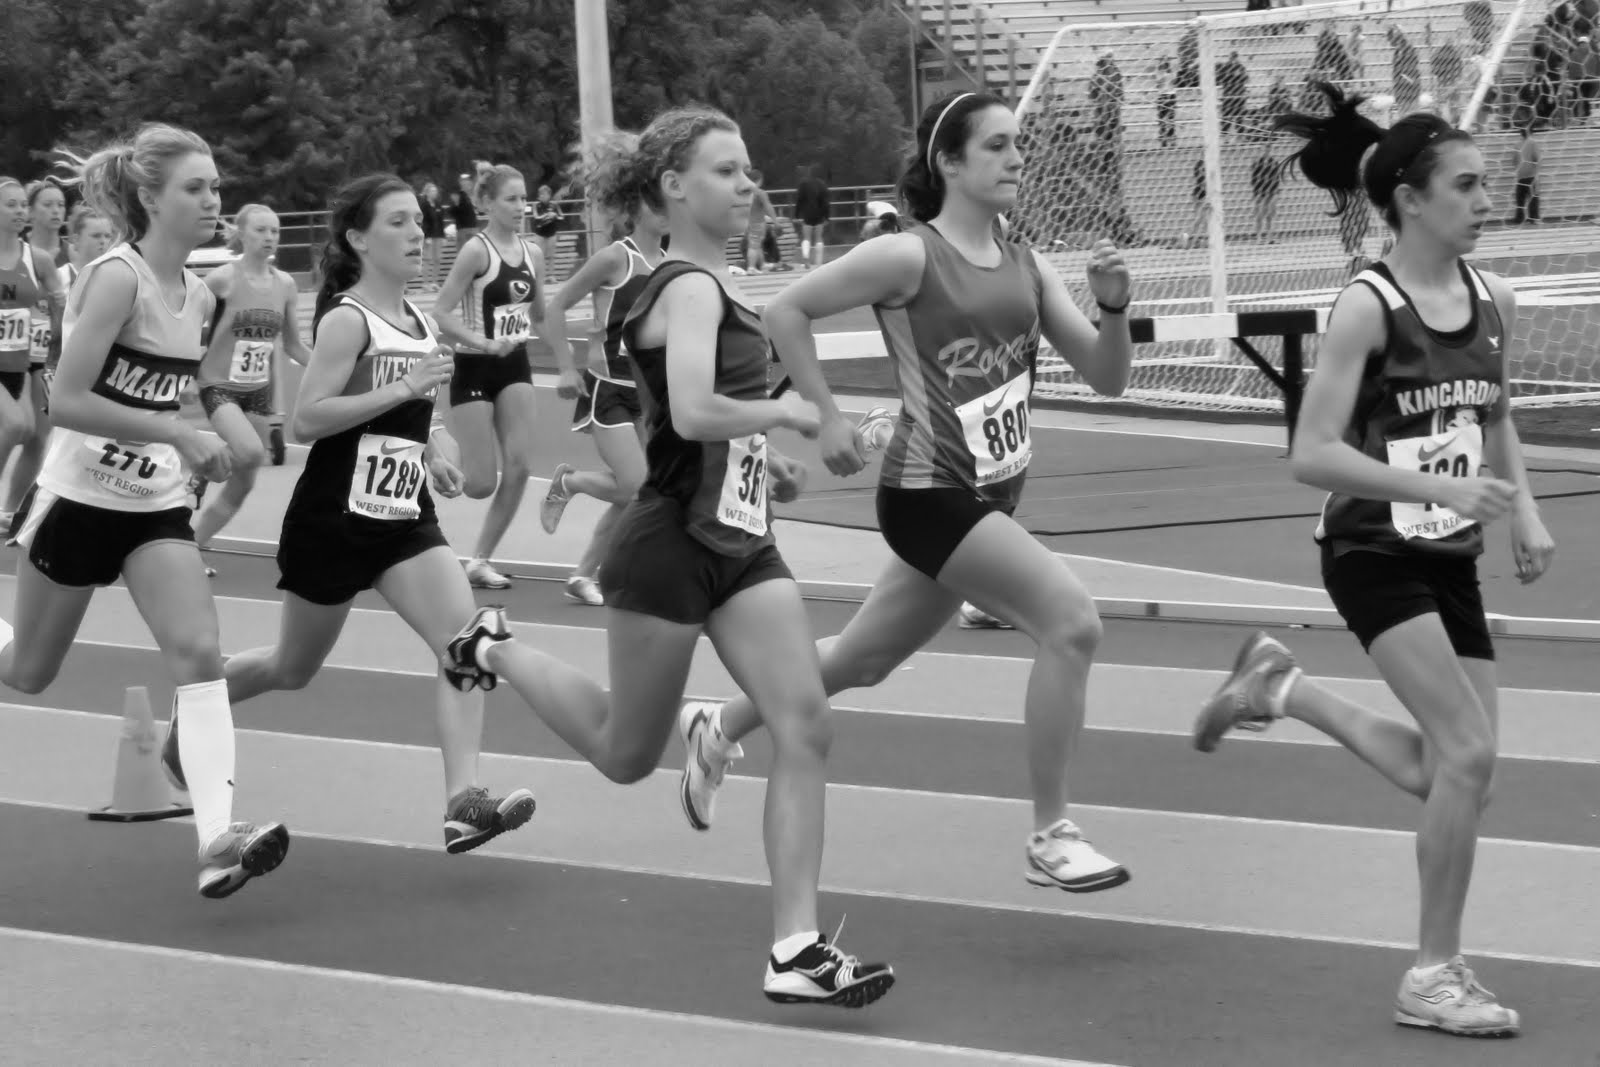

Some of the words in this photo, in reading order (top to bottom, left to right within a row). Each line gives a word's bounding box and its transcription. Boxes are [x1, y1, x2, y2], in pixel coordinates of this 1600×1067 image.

[983, 400, 1027, 461] 880
[365, 455, 420, 500] 1289
[356, 501, 387, 514] WEST
[1403, 521, 1440, 536] WEST
